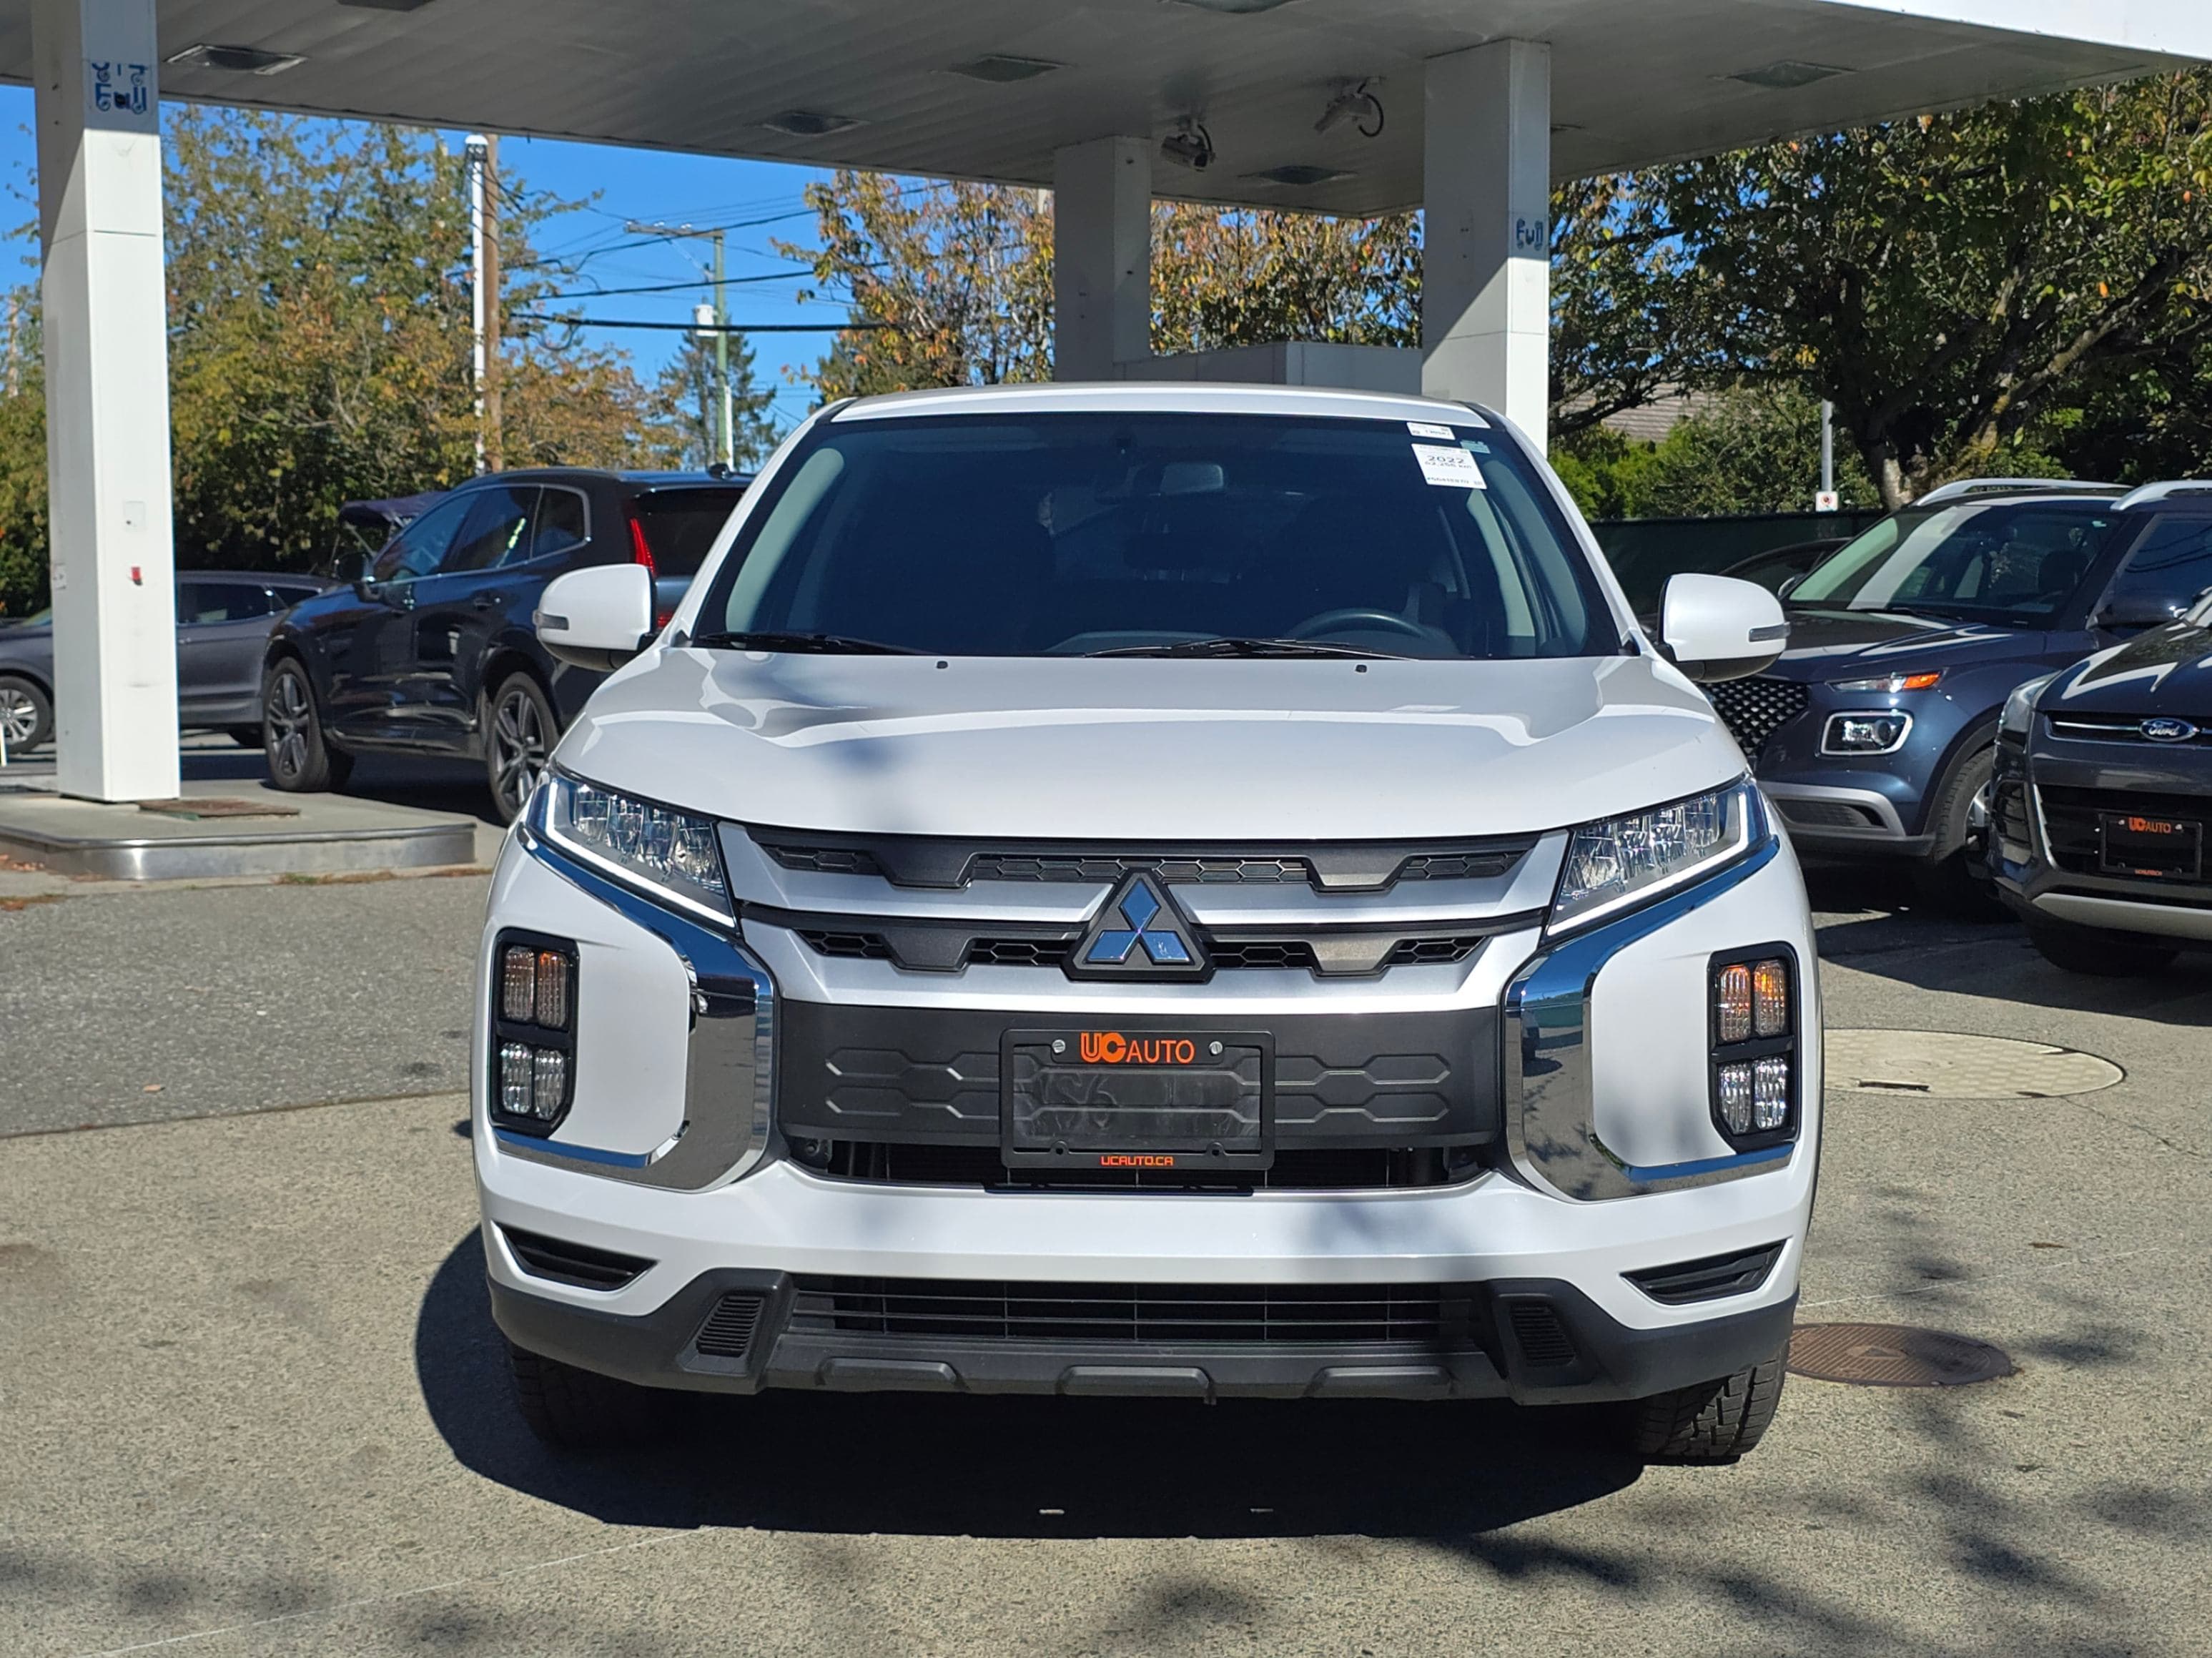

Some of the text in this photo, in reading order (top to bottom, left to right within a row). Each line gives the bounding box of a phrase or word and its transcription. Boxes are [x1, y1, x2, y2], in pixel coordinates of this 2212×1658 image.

[1427, 455, 1464, 464] 2022
[2148, 721, 2181, 736] Ford
[1100, 1155, 1173, 1166] UCAUTO.CA
